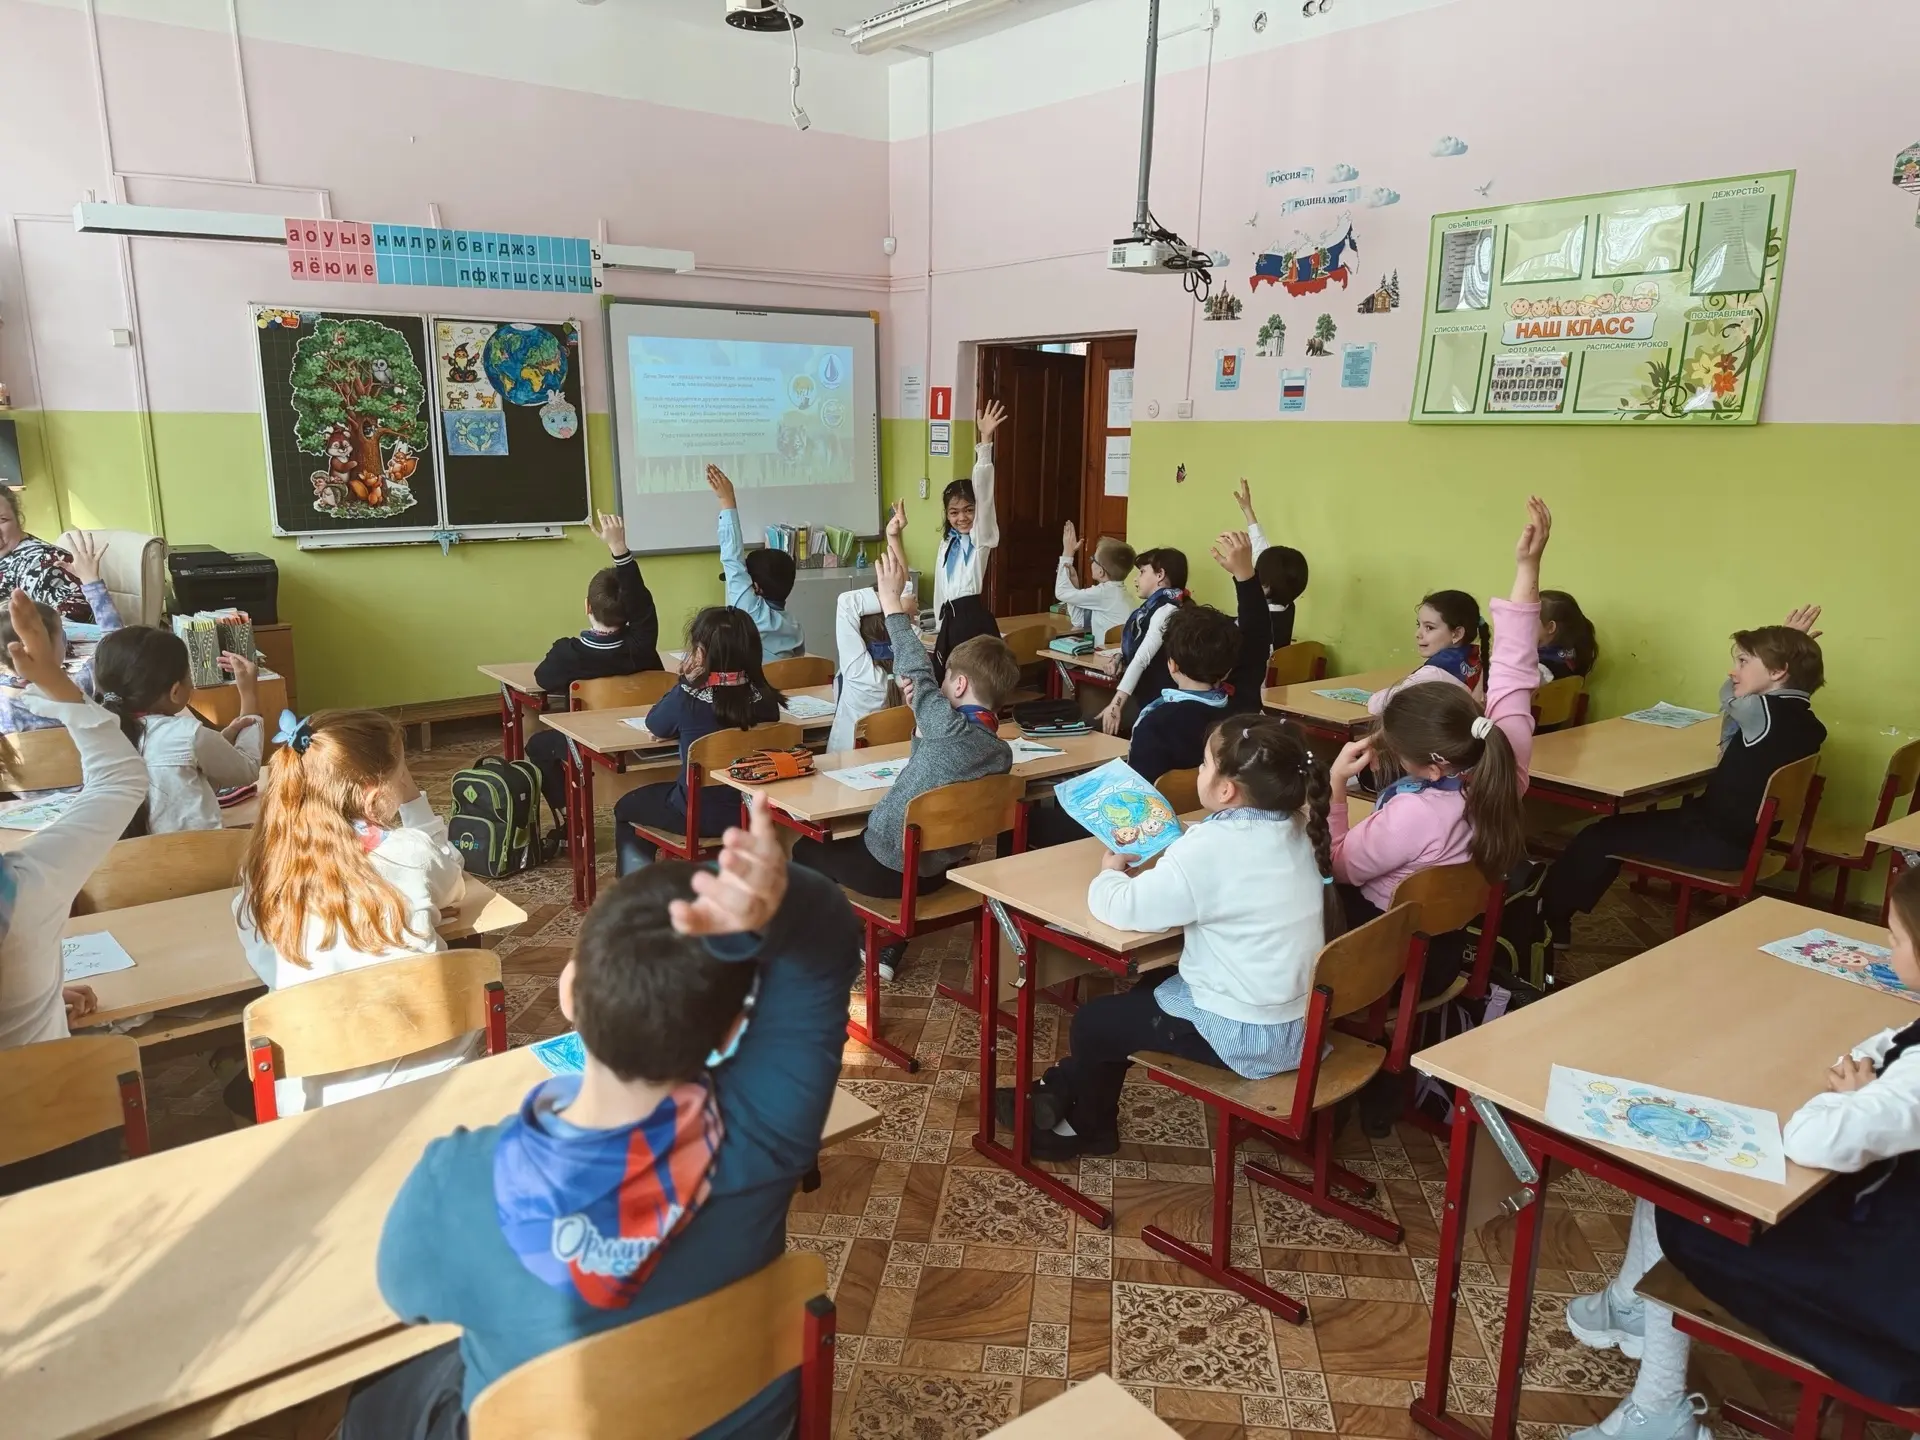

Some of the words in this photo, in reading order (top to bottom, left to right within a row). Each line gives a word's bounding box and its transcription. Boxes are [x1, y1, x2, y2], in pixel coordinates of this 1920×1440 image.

[1711, 186, 1765, 200] ДЕЖУРСТВО
[1294, 196, 1326, 208] РОДИНА
[1327, 195, 1347, 204] МОЯ!
[1448, 218, 1493, 230] ОБЪЯВЛЕНИЯ
[1691, 309, 1754, 319] ПОЗДРАВЛЯЕМ
[1515, 318, 1562, 339] НАШ
[1565, 316, 1635, 337] КЛАСС
[1507, 346, 1527, 354] ФОТО
[1528, 345, 1556, 353] КЛАССА
[1586, 342, 1636, 350] РАСПИСАНИЕ
[1637, 340, 1669, 348] УРОКОВ
